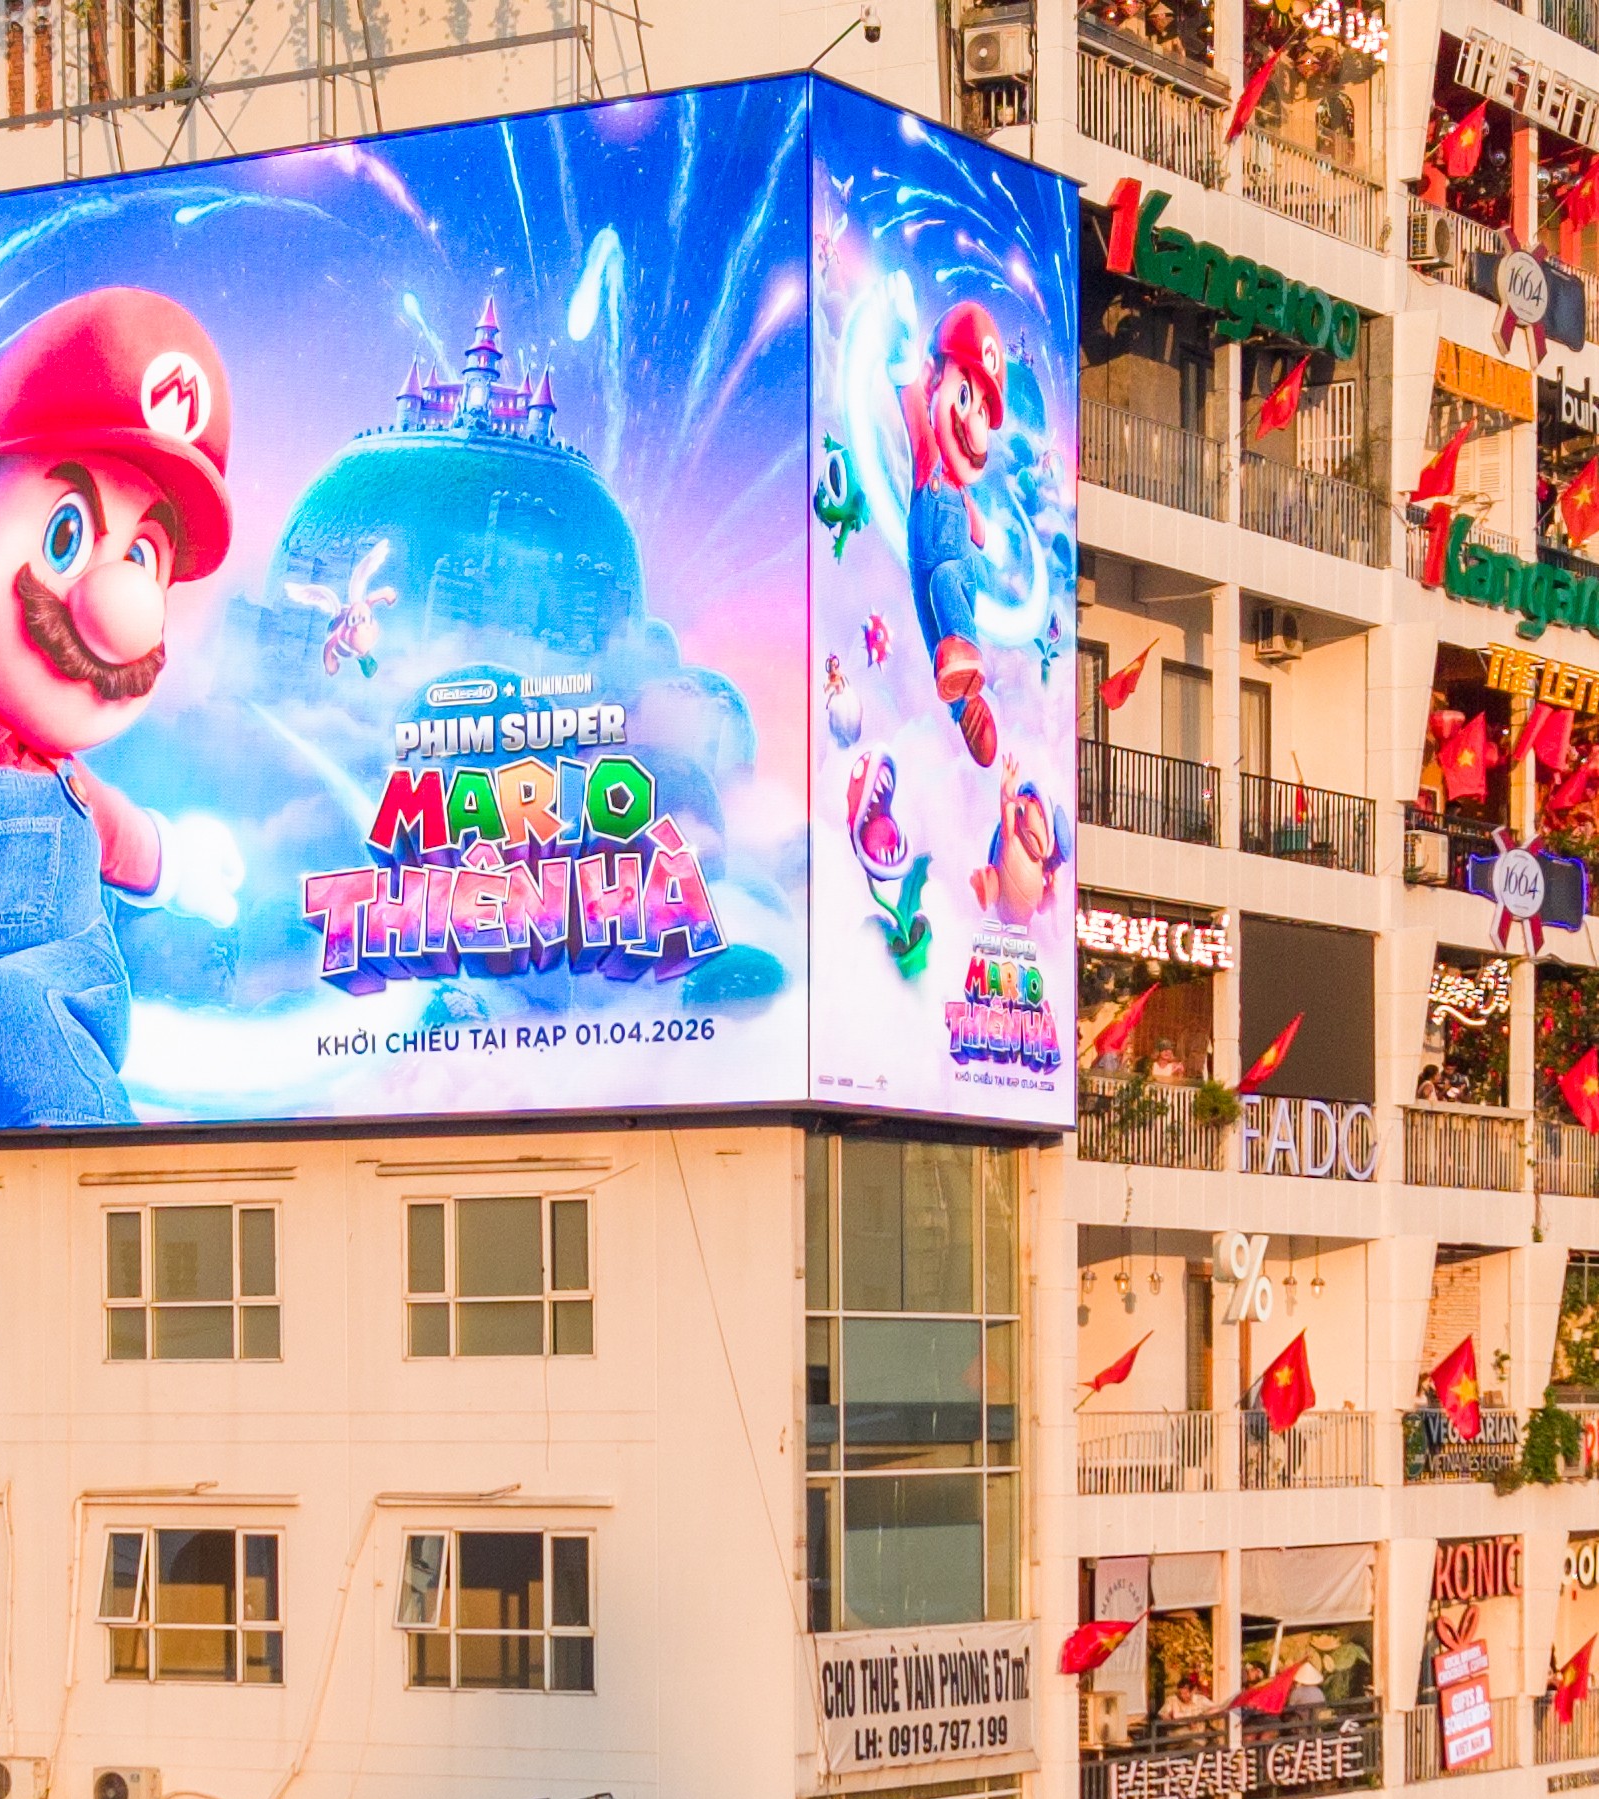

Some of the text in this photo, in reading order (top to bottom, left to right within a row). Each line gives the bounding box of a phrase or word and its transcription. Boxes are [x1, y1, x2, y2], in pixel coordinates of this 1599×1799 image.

[1454, 26, 1528, 112] THE
[1507, 266, 1543, 305] 1664
[431, 673, 593, 703] Nintendo ILLUMINATION
[1487, 642, 1536, 698] THE
[395, 703, 627, 761] PHIM SUPER
[366, 755, 657, 860] MARIO
[302, 813, 728, 985] THIÊN HÀ
[1502, 865, 1540, 901] 1664
[1002, 936, 1038, 962] SUPER
[964, 955, 1044, 1009] MARIO
[317, 1017, 716, 1057] KHỞI CHIẾU TẠI RẠP 01.04.2026
[945, 1001, 1062, 1076] THIÊN HÀ
[1240, 1094, 1378, 1181] FADO
[1424, 1411, 1519, 1444] VEGARIAN
[822, 1659, 857, 1720] CHO
[860, 1644, 901, 1715] THUÊ
[903, 1642, 936, 1712] VĂN
[939, 1637, 991, 1708] PHÒNG
[854, 1714, 1008, 1761] LH: 0919.797.199
